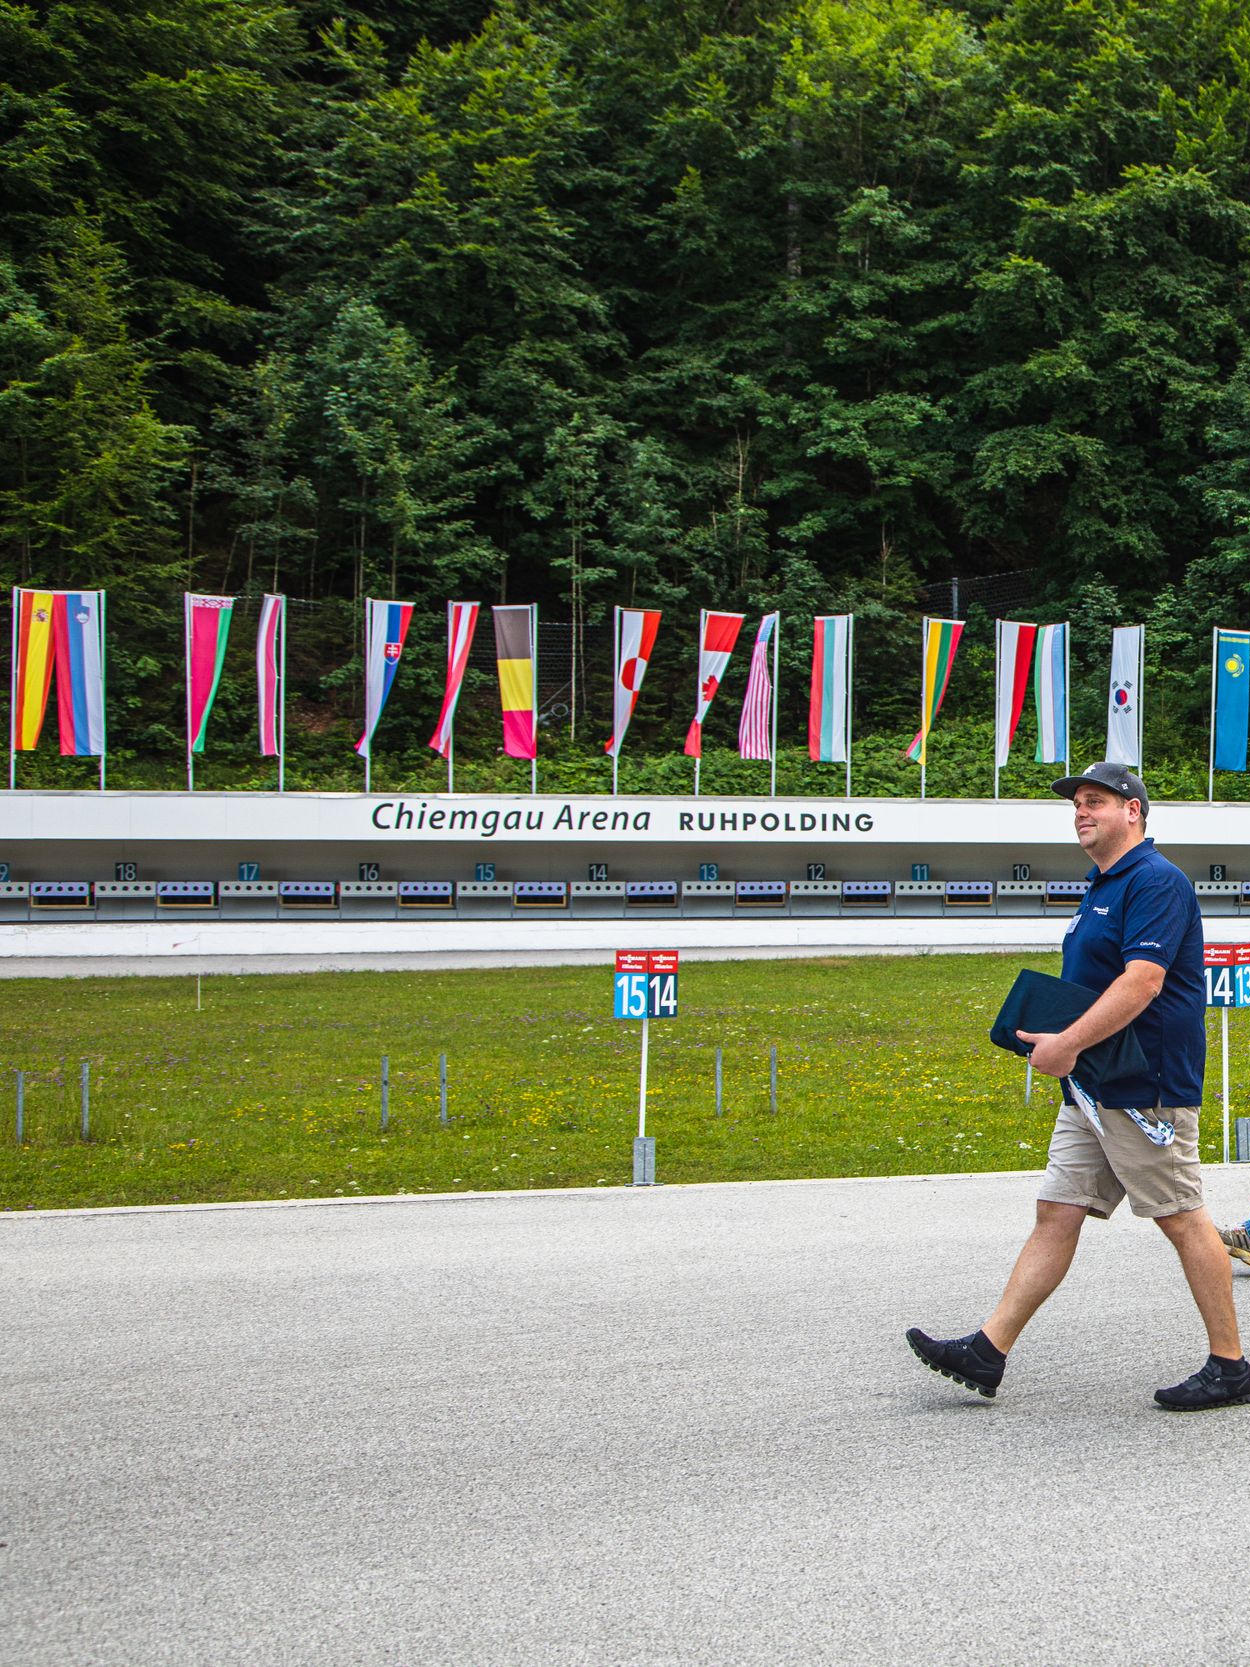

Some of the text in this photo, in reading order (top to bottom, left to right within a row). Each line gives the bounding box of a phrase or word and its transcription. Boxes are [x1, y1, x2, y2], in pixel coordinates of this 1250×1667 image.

[373, 803, 874, 838] Chiemgau Arena RUHPOLDING
[117, 864, 135, 881] 18
[239, 864, 257, 881] 17
[361, 864, 378, 881] 16
[478, 864, 494, 881] 15
[590, 865, 607, 881] 14
[701, 865, 717, 881] 13
[809, 865, 824, 881] 12
[914, 865, 927, 881] 11
[1014, 865, 1029, 881] 10
[1214, 865, 1222, 881] 8
[1203, 967, 1234, 1005] 14
[617, 975, 646, 1016] 15
[649, 975, 677, 1016] 14
